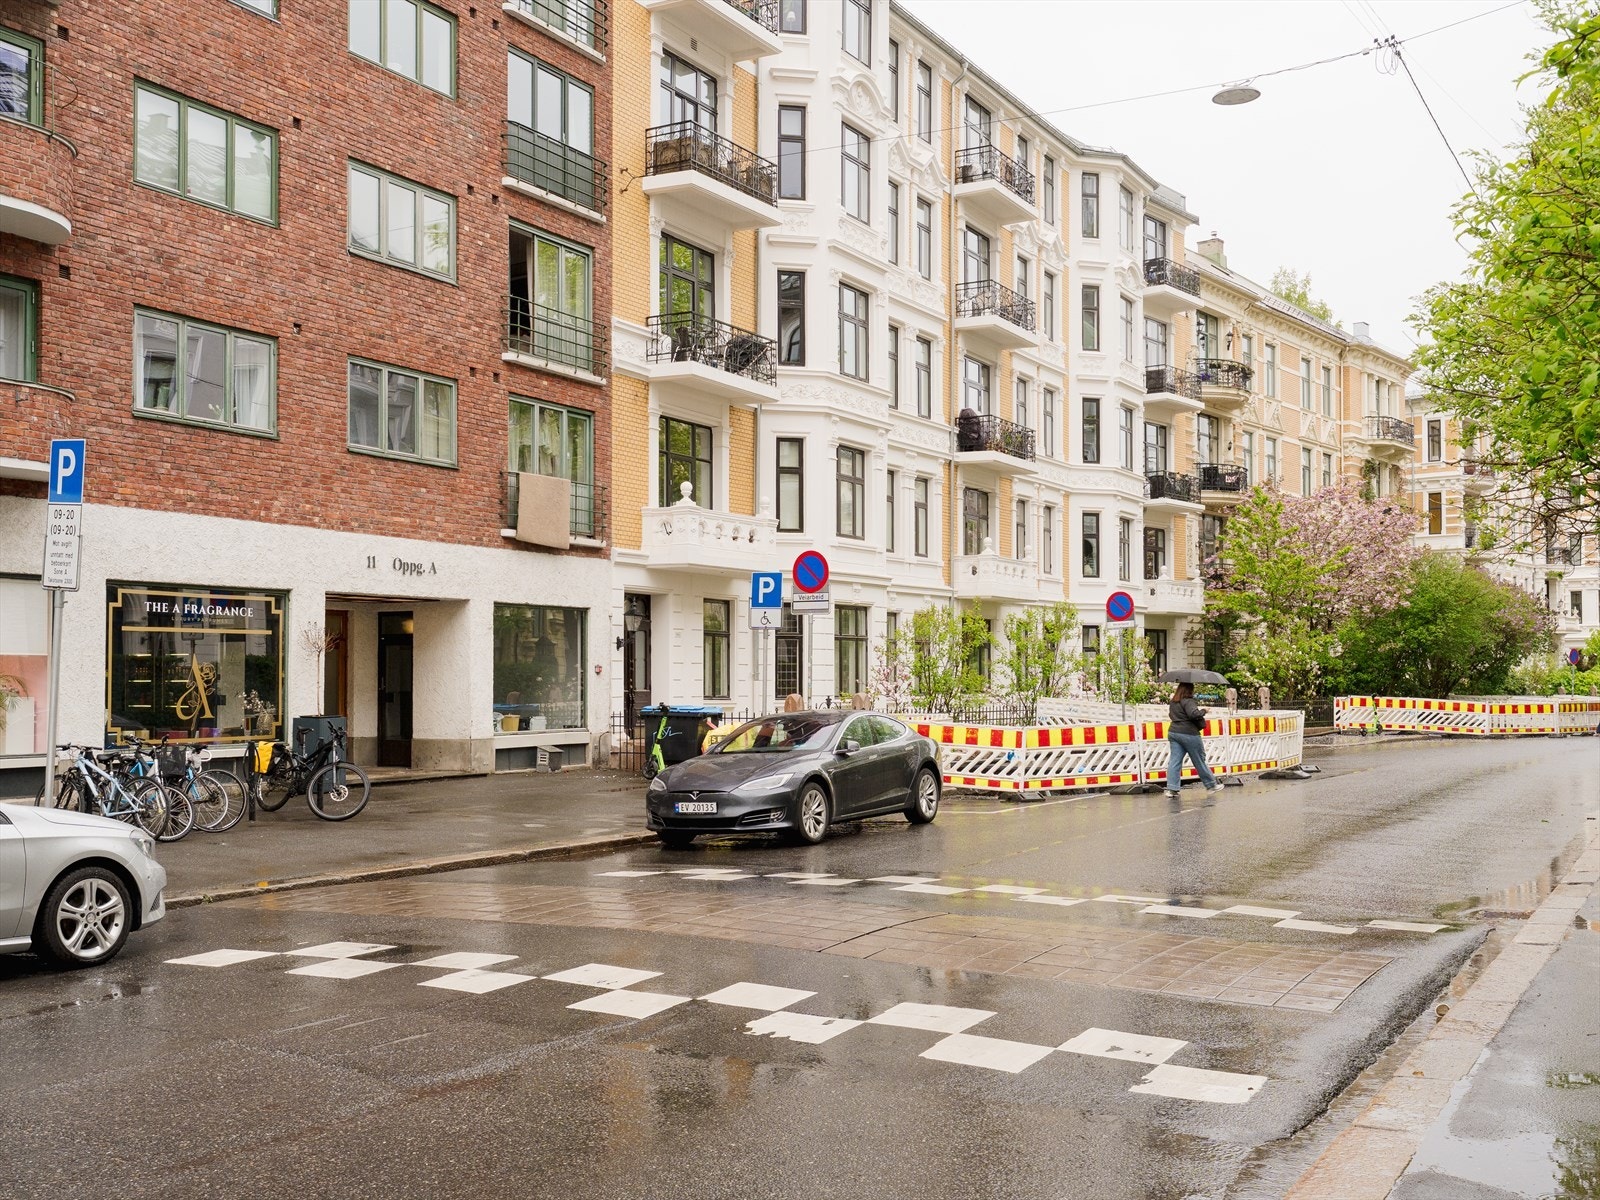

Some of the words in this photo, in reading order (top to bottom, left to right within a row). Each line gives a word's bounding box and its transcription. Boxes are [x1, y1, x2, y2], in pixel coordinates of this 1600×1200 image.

[57, 448, 76, 495] P
[54, 509, 74, 519] 09-20
[51, 524, 76, 536] (09-20)
[367, 555, 376, 568] 11
[393, 557, 425, 576] Oppg.
[428, 562, 437, 575] A
[758, 577, 775, 603] P
[144, 602, 169, 613] THE
[172, 603, 180, 613] A
[184, 603, 254, 617] FRAGRANCE
